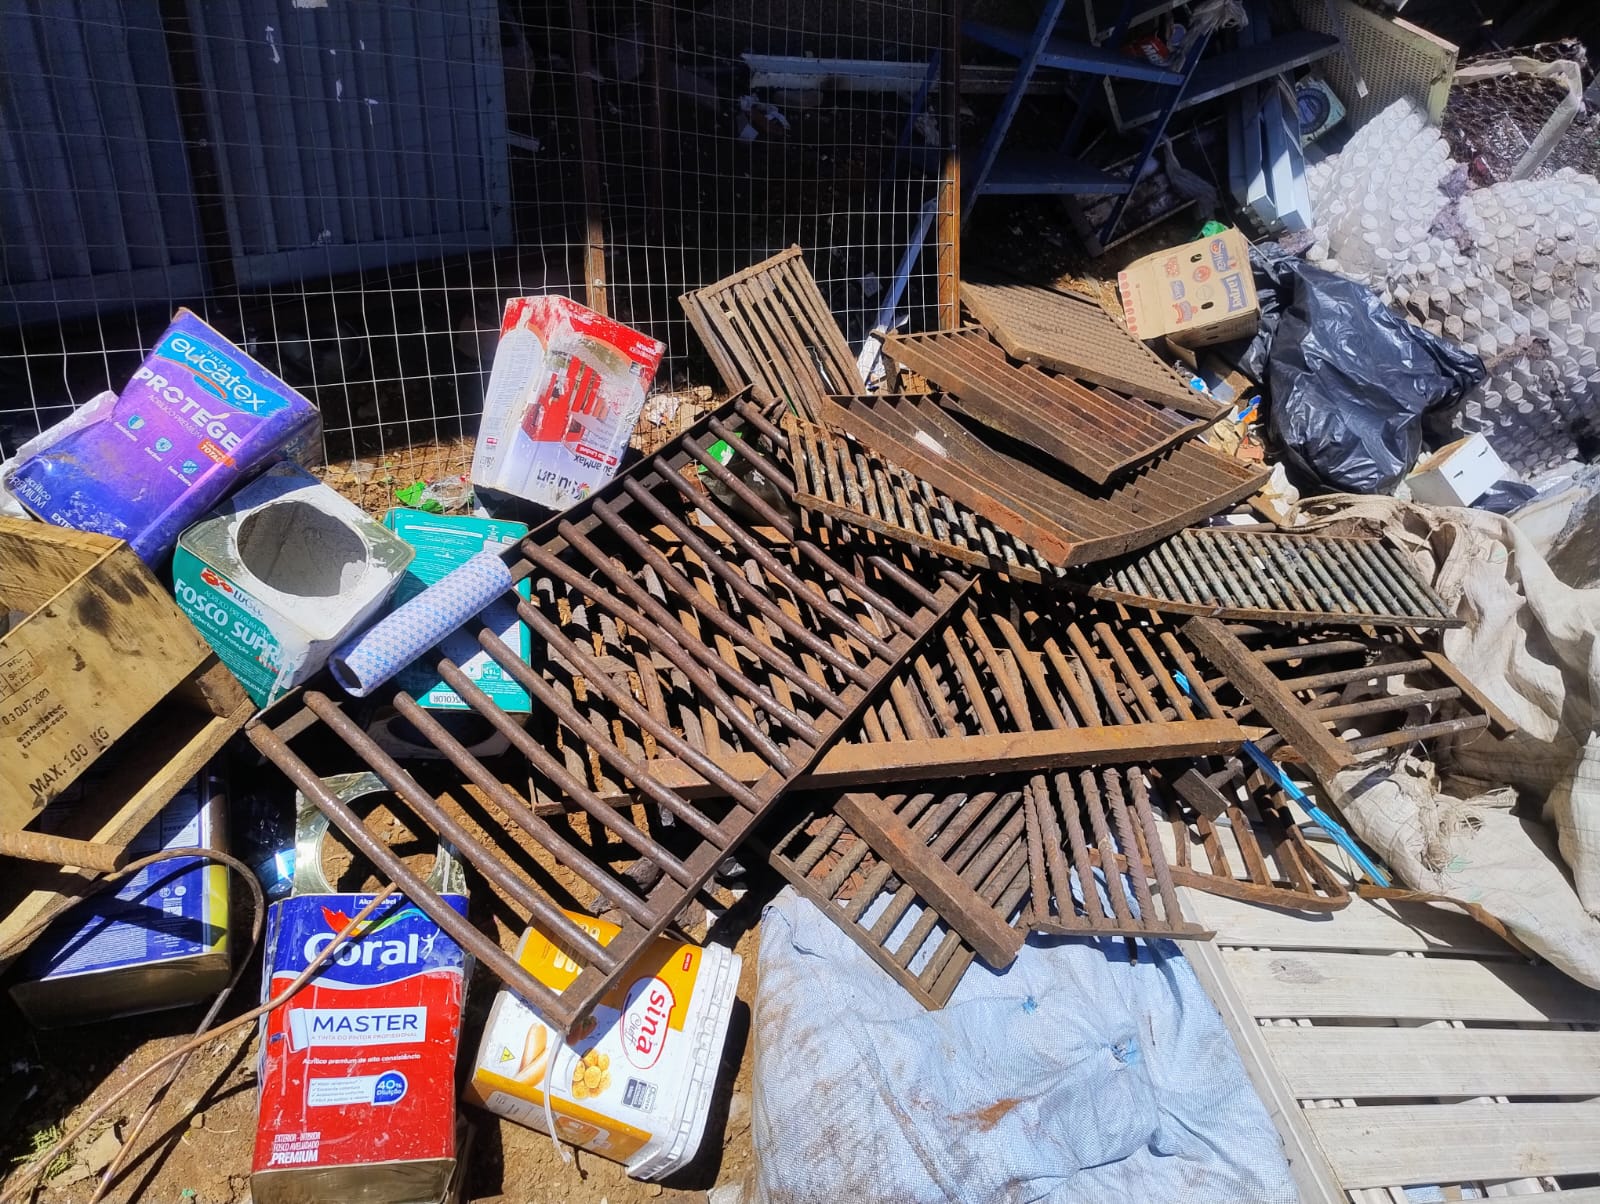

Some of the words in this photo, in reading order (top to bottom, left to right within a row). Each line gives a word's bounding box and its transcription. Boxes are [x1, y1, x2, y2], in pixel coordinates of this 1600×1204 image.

[170, 338, 266, 412] eucatex
[201, 445, 222, 463] TOTAL
[8, 472, 47, 508] PREMIUM
[174, 578, 228, 626] FOSCO
[2, 712, 16, 726] 03
[14, 700, 33, 717] OUT
[64, 744, 89, 767] 100
[90, 726, 110, 747] KG
[303, 932, 419, 967] Coral
[313, 1014, 418, 1032] MASTER
[636, 990, 666, 1054] sina
[377, 1079, 402, 1089] 40%
[272, 1150, 318, 1165] PREMIUM
